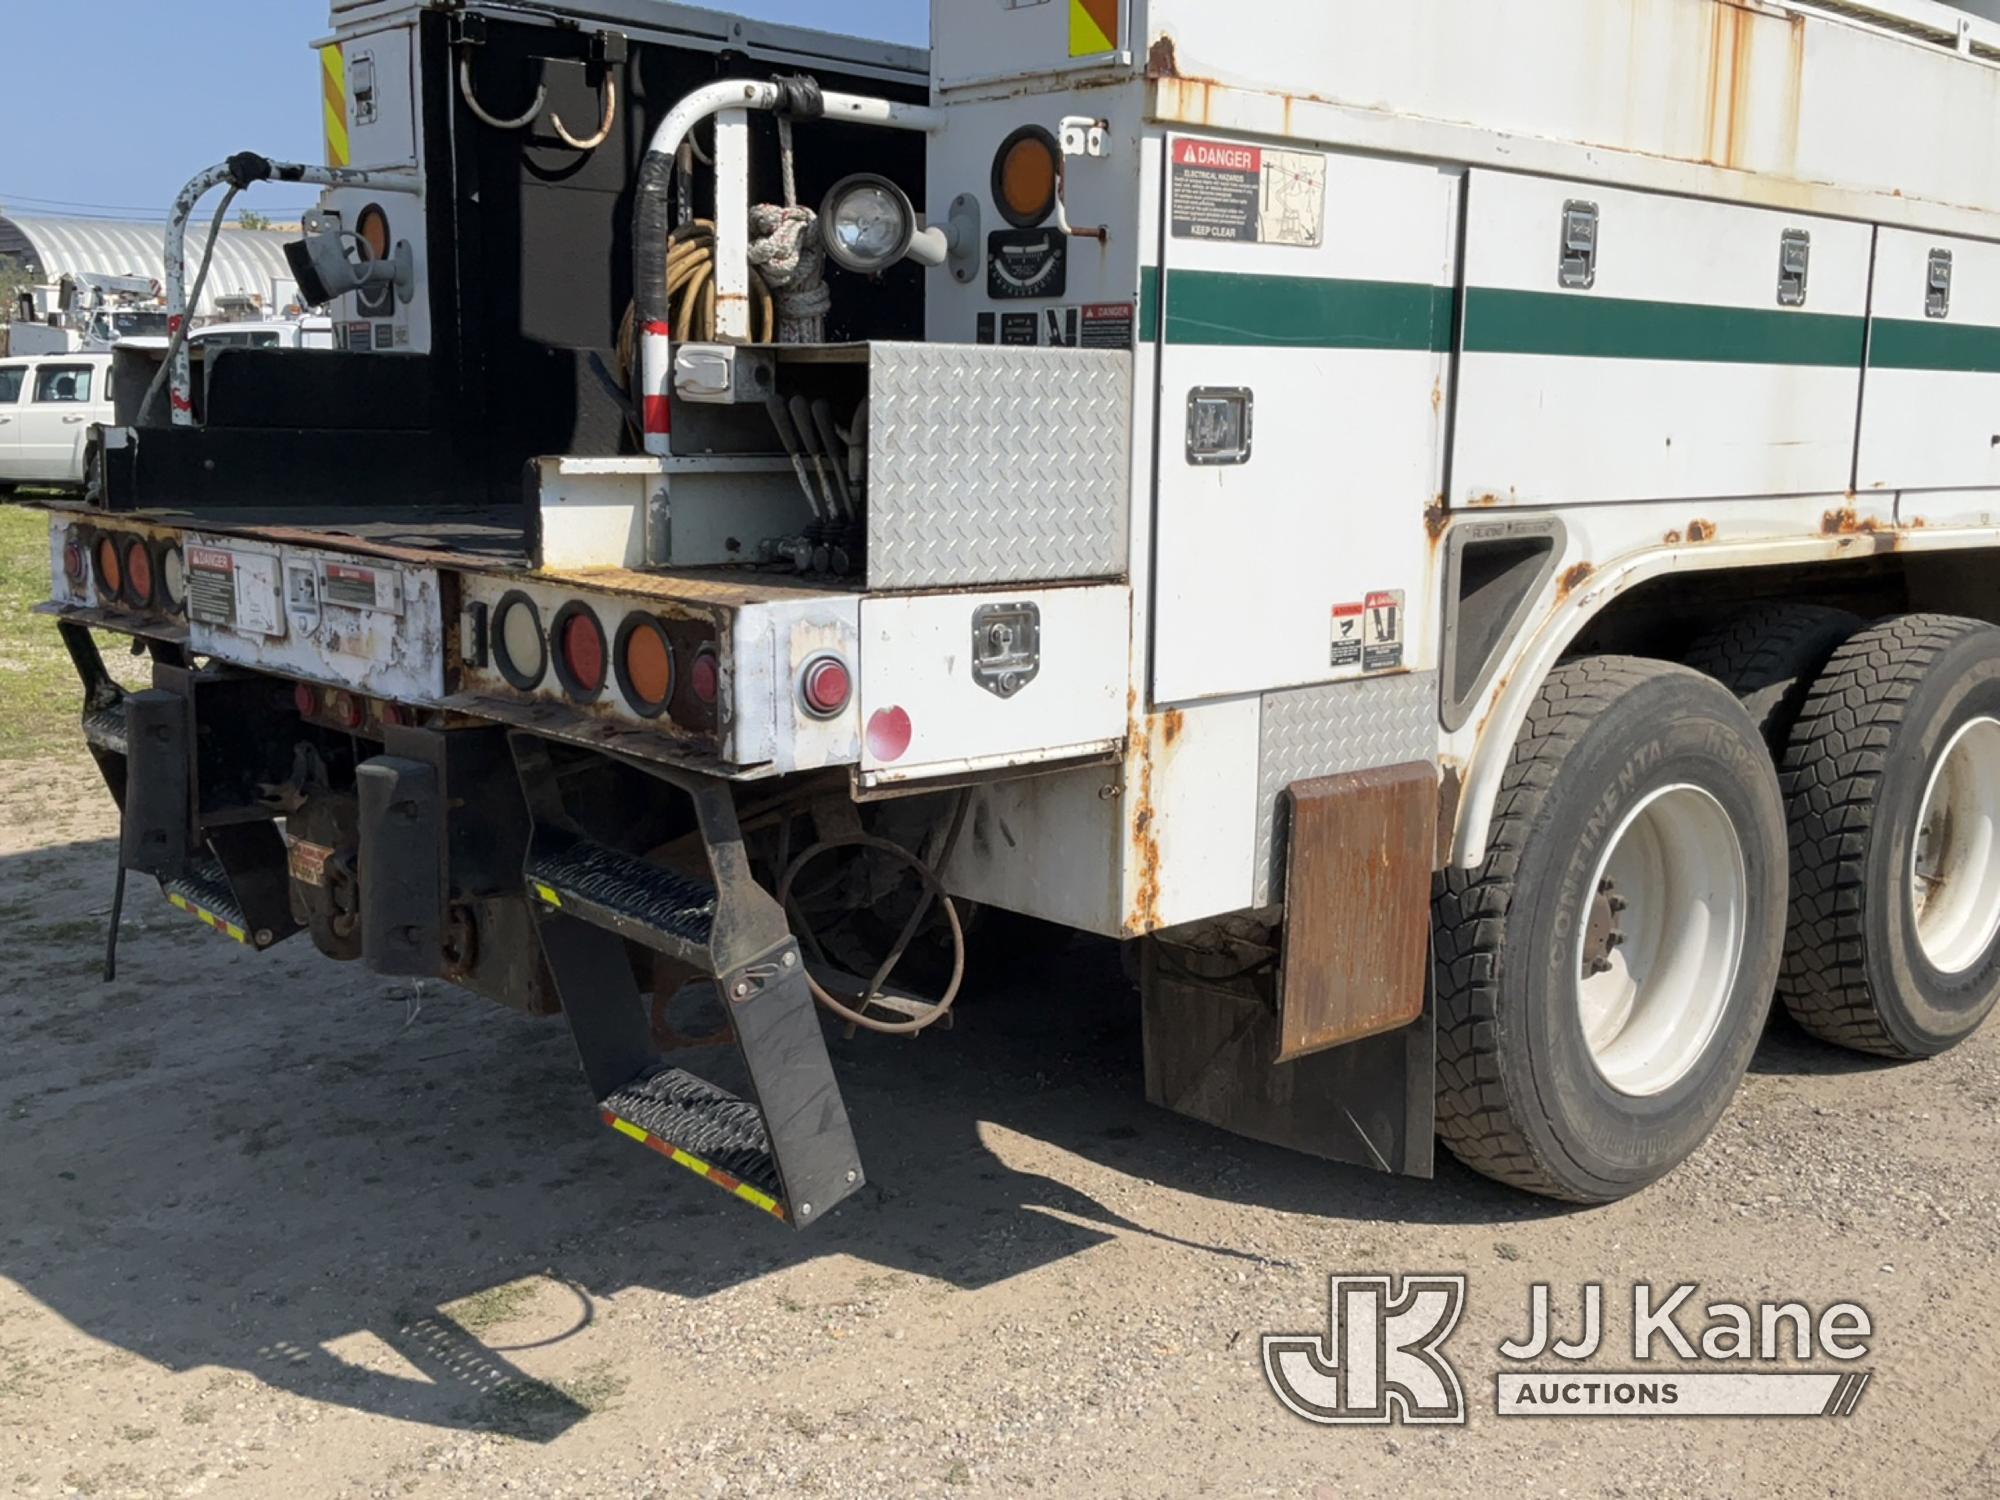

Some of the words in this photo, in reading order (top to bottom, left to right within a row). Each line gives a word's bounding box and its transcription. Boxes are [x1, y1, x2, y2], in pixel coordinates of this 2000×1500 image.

[1198, 147, 1252, 168] DANGER
[1191, 225, 1210, 236] KEEP
[1211, 227, 1236, 238] CLEAR
[1097, 306, 1129, 318] DANGER
[198, 550, 228, 569] DANGER
